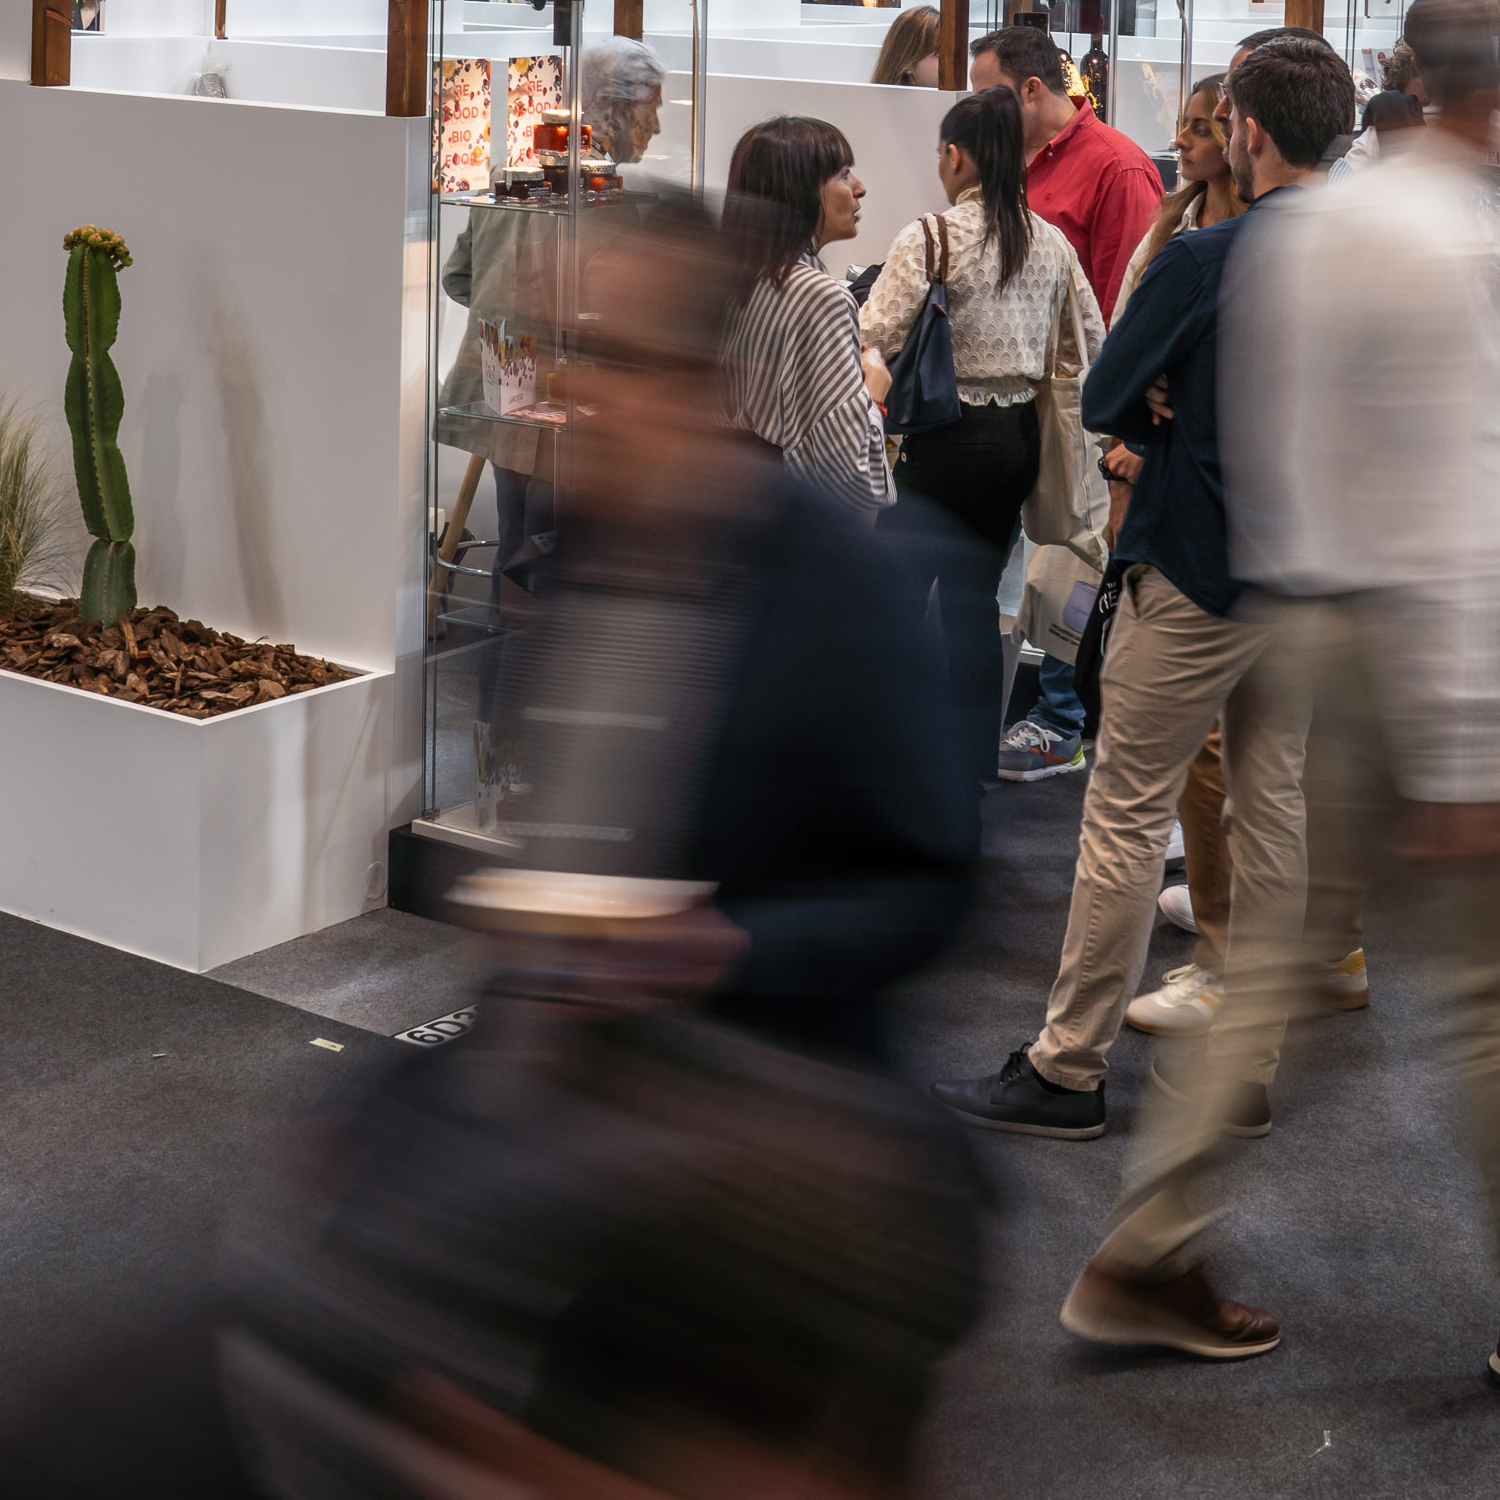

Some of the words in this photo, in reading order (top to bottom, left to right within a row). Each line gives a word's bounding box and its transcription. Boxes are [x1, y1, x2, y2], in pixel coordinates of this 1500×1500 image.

[453, 106, 479, 120] OOD
[526, 102, 550, 114] OOD
[452, 130, 472, 143] BIO
